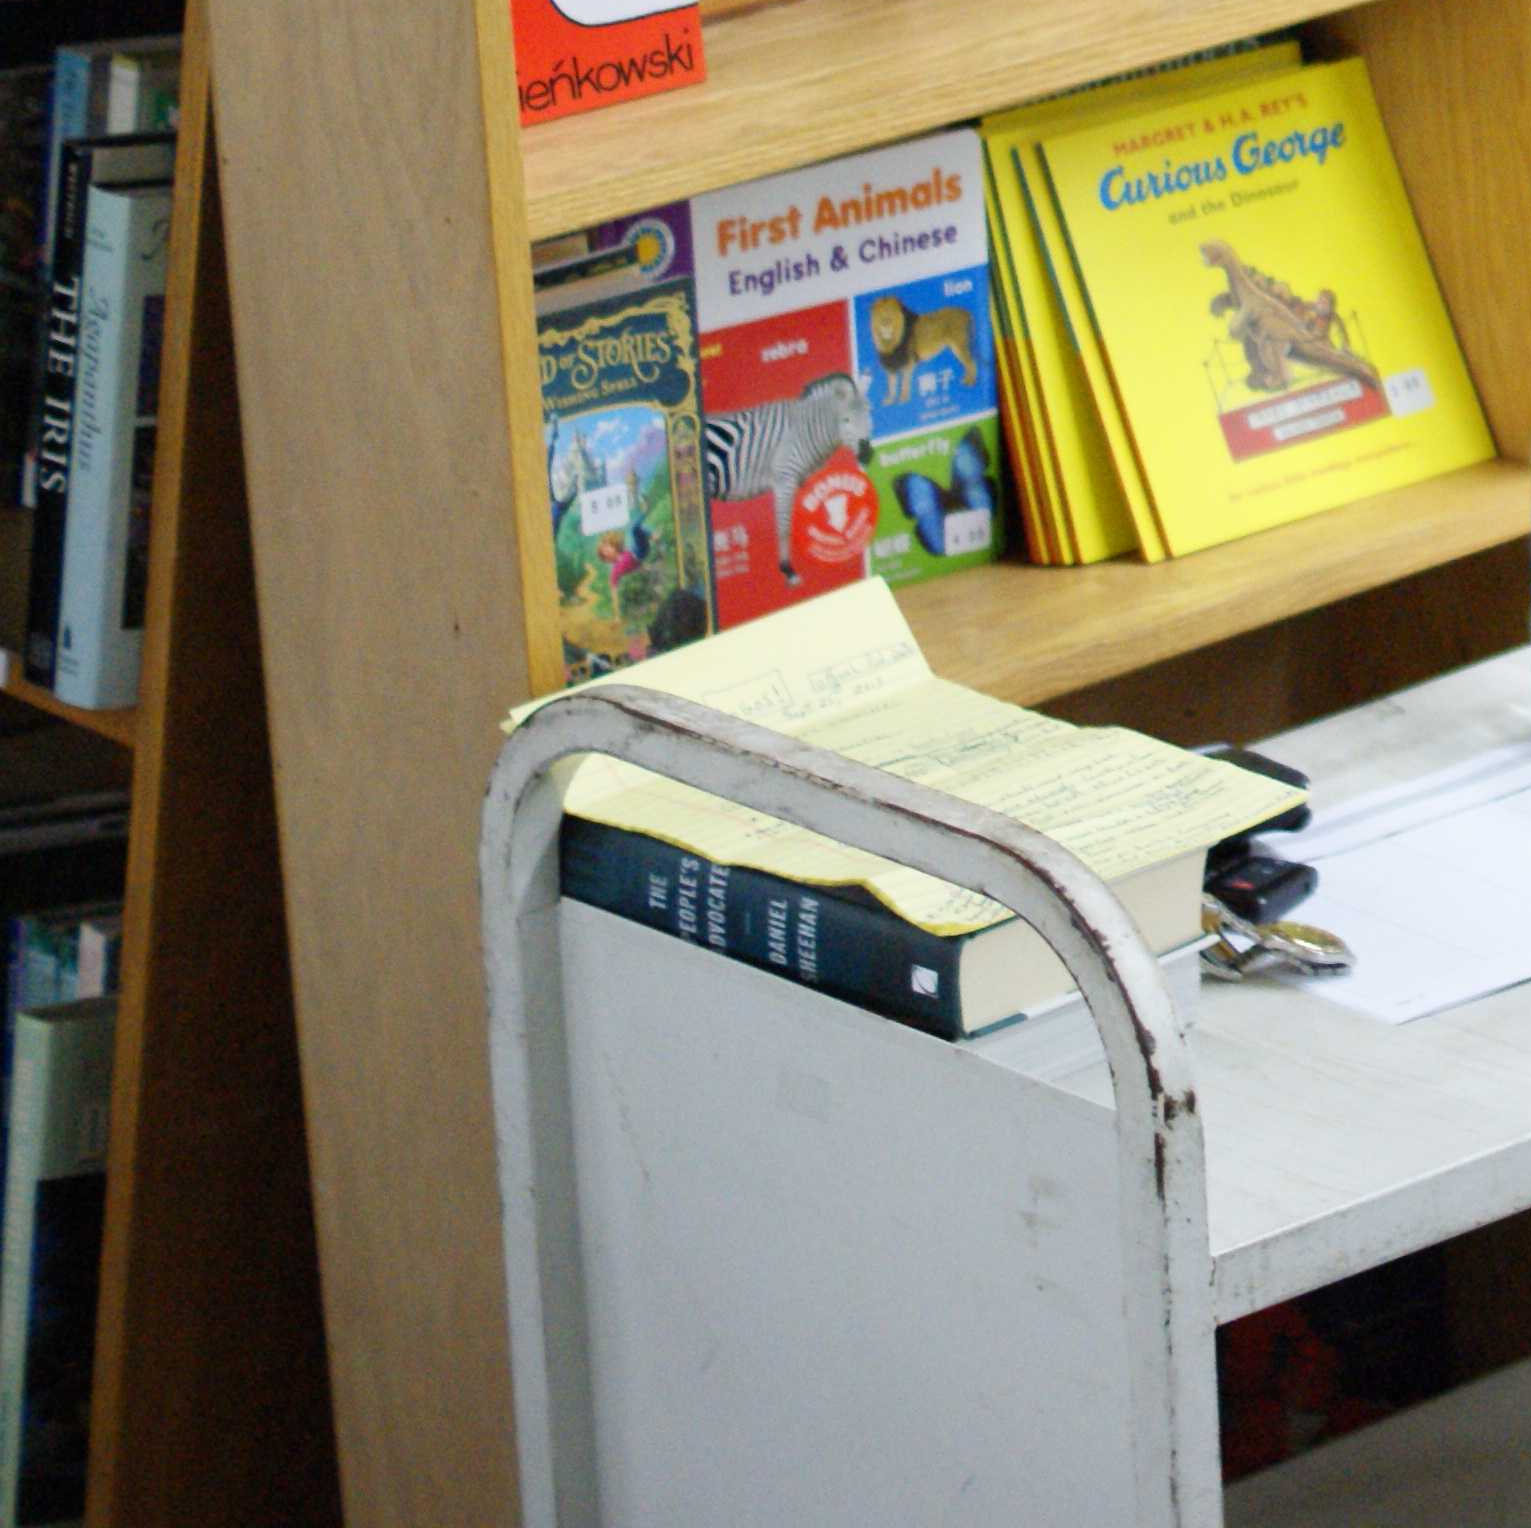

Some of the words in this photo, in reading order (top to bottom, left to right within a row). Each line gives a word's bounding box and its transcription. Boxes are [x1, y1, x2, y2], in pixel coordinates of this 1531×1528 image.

[518, 26, 695, 113] ieńkowski
[1112, 122, 1198, 159] MARGRET
[1259, 93, 1308, 120] REY'S
[1099, 158, 1228, 212] Curious
[1231, 121, 1347, 176] George
[1201, 199, 1227, 217] the
[1230, 179, 1300, 209] Dinosaur
[716, 205, 803, 258] First
[813, 167, 963, 234] Animals
[729, 253, 820, 296] English
[829, 245, 849, 273] &
[858, 225, 958, 264] Chinese
[943, 279, 974, 297] lion
[45, 277, 80, 378] THE
[570, 327, 672, 391] STORIES
[760, 339, 809, 364] zebra
[40, 401, 72, 494] IRIS
[879, 438, 950, 468] butterfly
[649, 873, 669, 910] THE
[708, 864, 731, 949] DVOCATE
[767, 899, 789, 965] DANIEL
